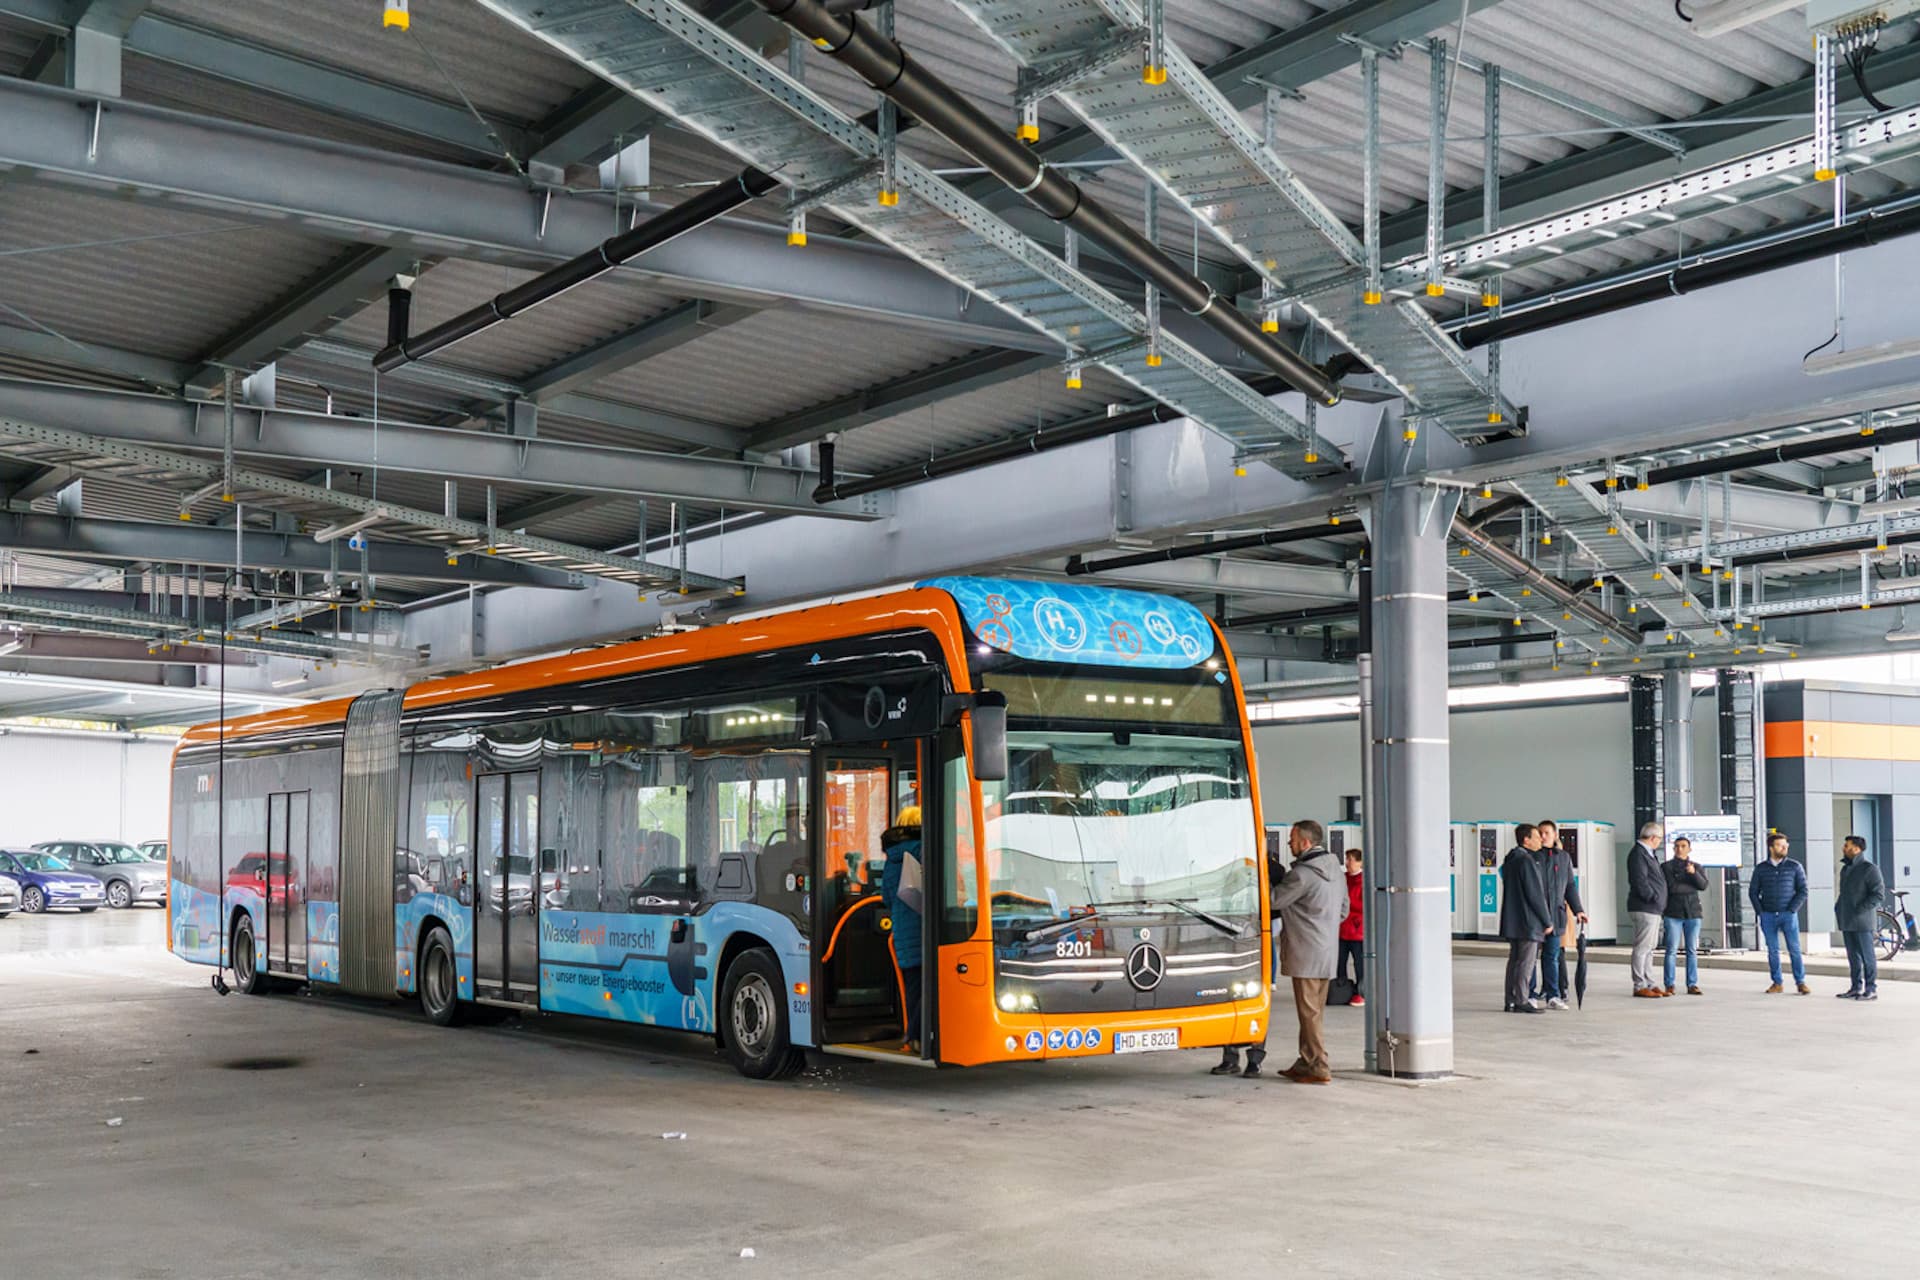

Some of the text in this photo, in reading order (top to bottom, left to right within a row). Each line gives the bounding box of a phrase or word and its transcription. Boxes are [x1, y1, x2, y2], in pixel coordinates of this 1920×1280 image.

[543, 923, 655, 950] Wasserstoff marsch!
[1056, 941, 1092, 959] 8201
[556, 971, 576, 984] unser
[578, 974, 600, 986] neuer
[602, 973, 665, 994] Energiebooster
[1121, 1032, 1176, 1048] HD E 8201
